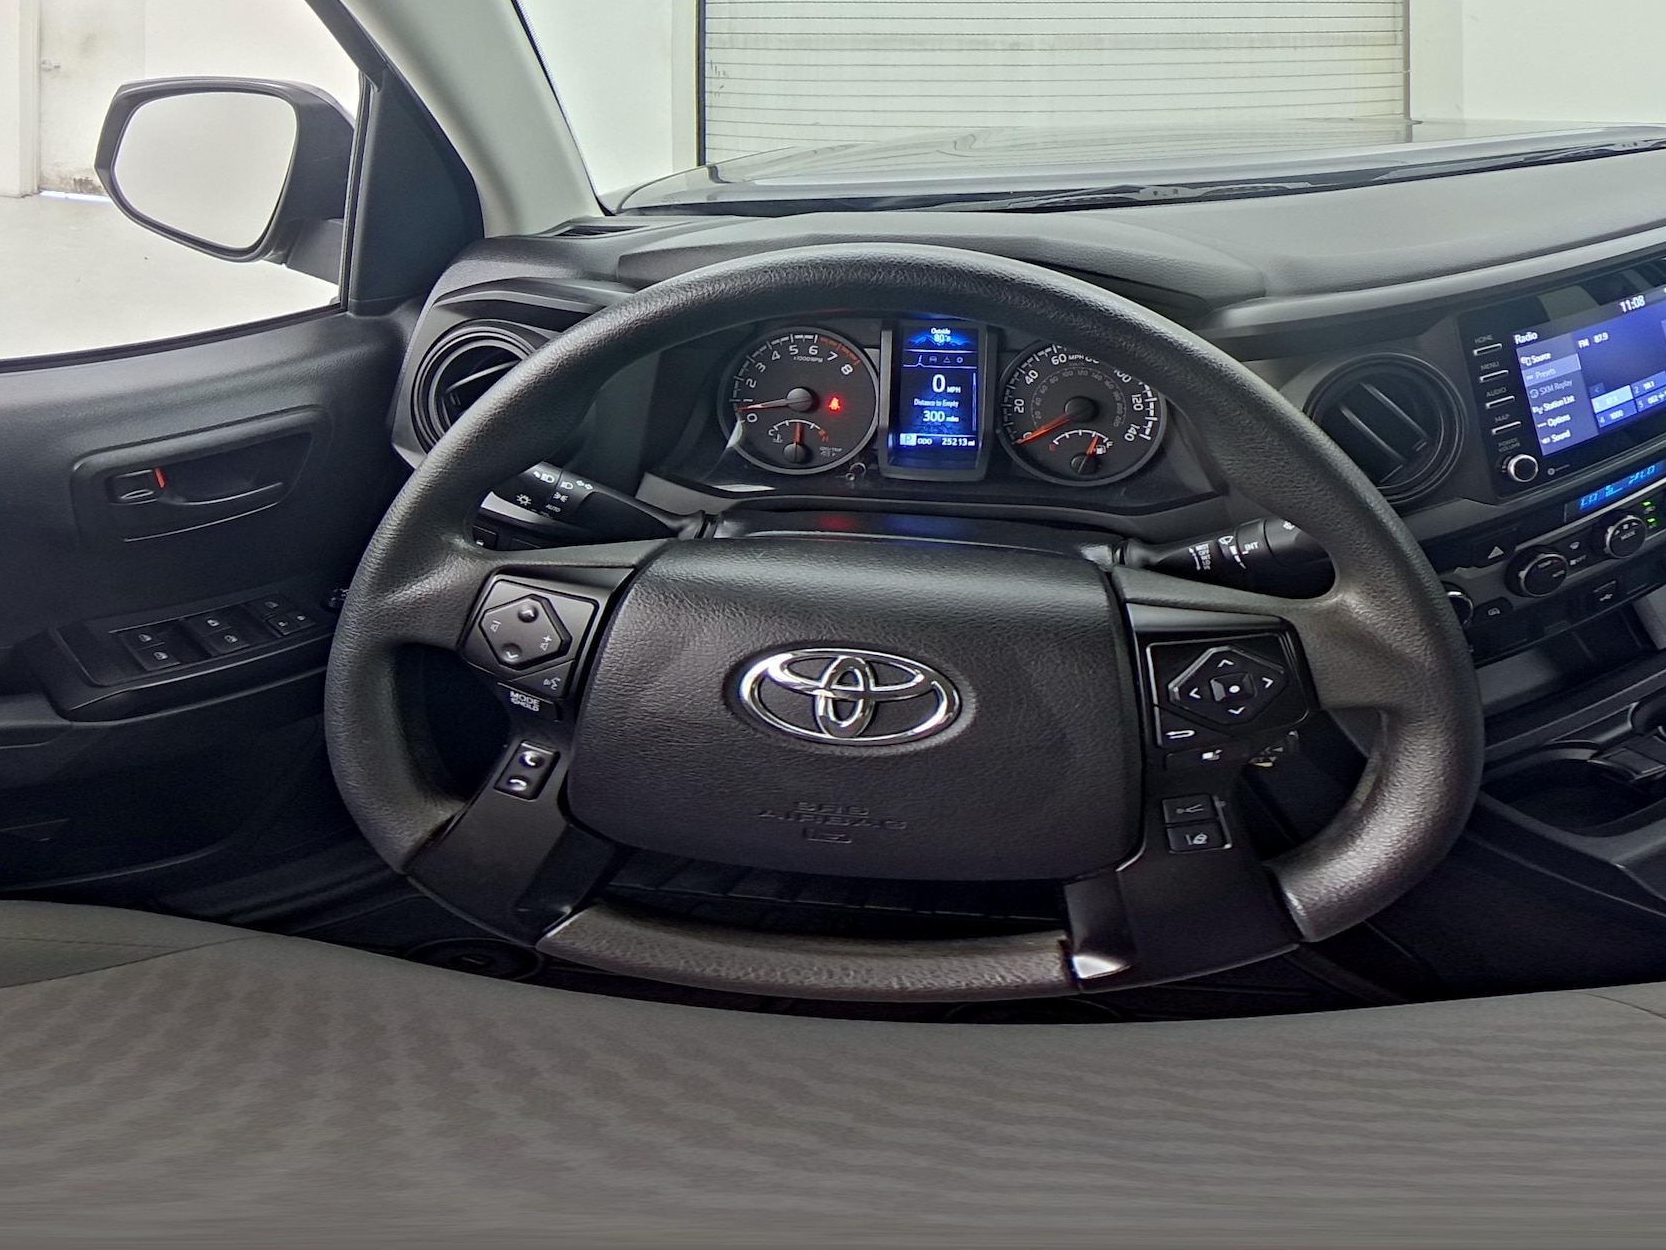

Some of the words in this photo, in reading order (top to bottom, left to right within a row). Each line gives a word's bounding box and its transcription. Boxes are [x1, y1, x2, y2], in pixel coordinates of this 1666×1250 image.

[1619, 295, 1646, 313] 11:08
[1474, 334, 1493, 344] HOME
[1514, 331, 1538, 345] Radio
[1578, 338, 1590, 348] FM
[788, 344, 799, 355] 5
[808, 345, 819, 355] 6
[771, 350, 782, 361] 4
[827, 351, 838, 361] 7
[1051, 353, 1067, 365] 60
[1531, 352, 1551, 364] Source
[755, 362, 767, 373] 3
[840, 363, 853, 375] 8
[1480, 361, 1500, 370] MENU
[1024, 369, 1038, 384] 40
[1535, 368, 1556, 380] Presets
[745, 378, 757, 388] 2
[932, 374, 946, 393] 0
[1539, 385, 1554, 396] SXM
[1554, 380, 1573, 391] Replay
[1486, 387, 1507, 397] AUDIO
[942, 400, 959, 408] Empty
[1014, 399, 1024, 413] 20
[1131, 394, 1144, 411] 120
[1543, 399, 1564, 412] Station
[1563, 395, 1575, 405] List
[746, 413, 758, 423] 0
[923, 411, 945, 422] 300
[1495, 414, 1510, 422] MAP
[1547, 414, 1571, 427] Options
[1124, 424, 1140, 441] 140
[1551, 430, 1571, 442] Sound
[545, 504, 561, 513] AUTO
[1244, 541, 1259, 550] INT
[510, 691, 540, 705] MODE
